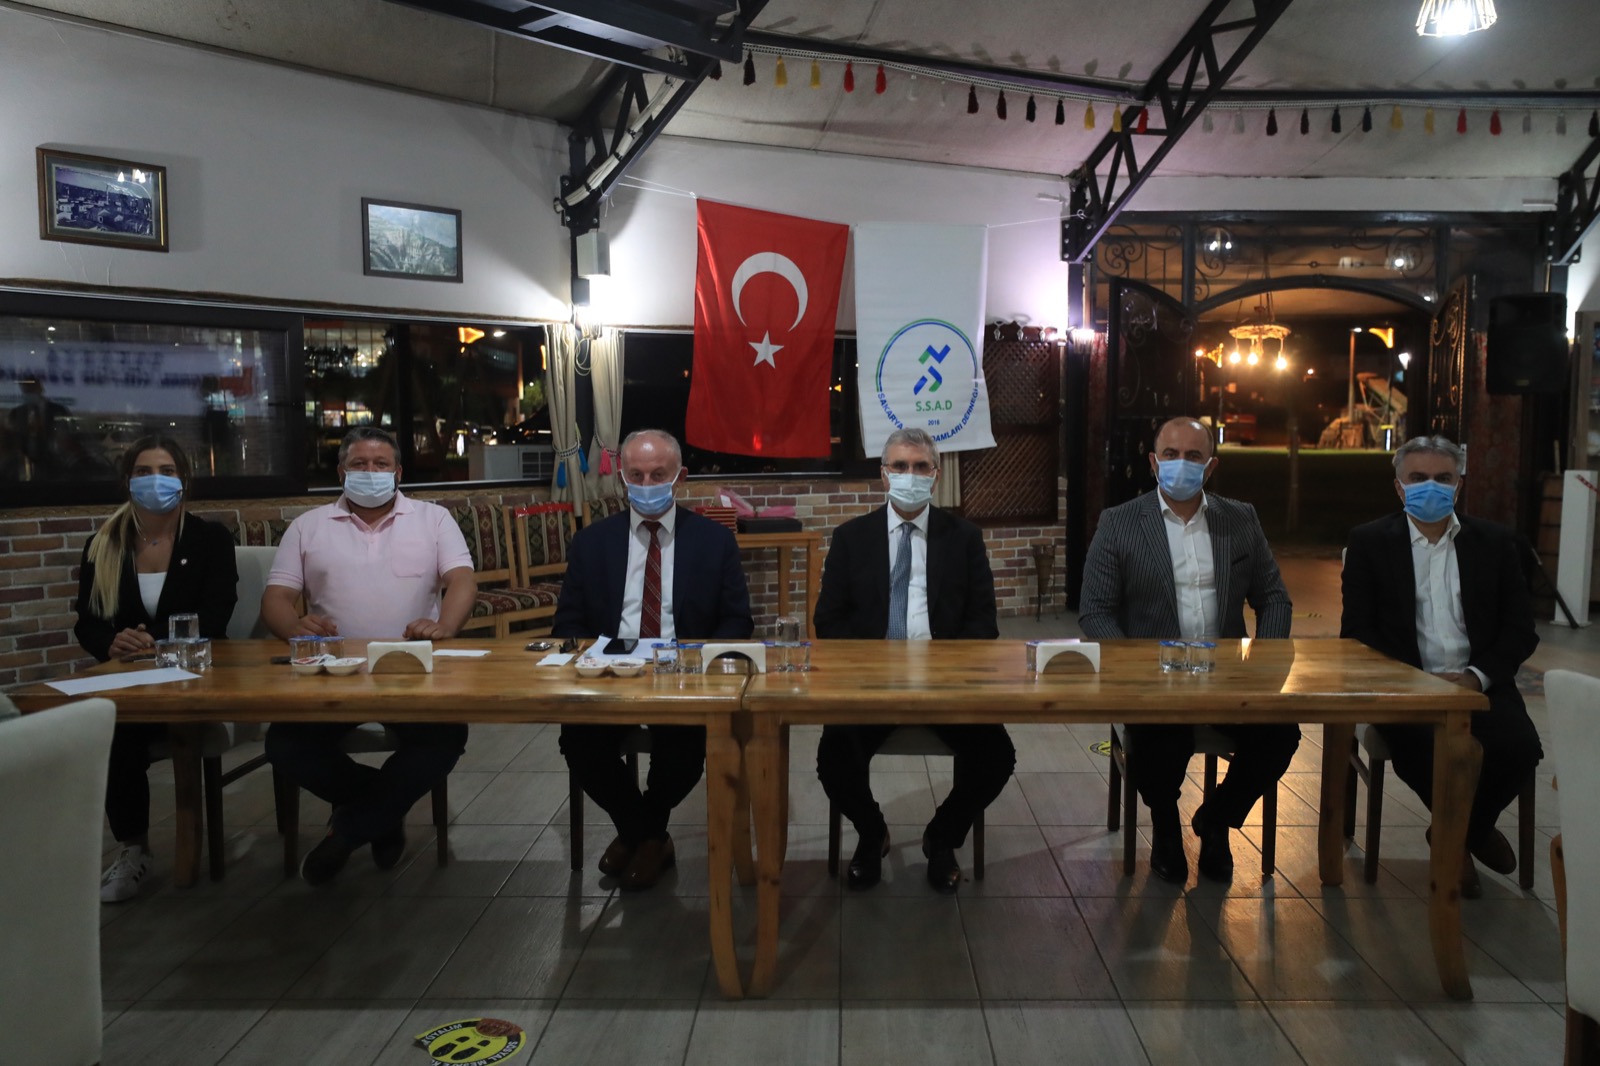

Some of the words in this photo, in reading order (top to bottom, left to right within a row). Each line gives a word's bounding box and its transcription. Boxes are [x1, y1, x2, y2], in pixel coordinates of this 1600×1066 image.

[878, 393, 903, 430] SAKARYA
[932, 424, 963, 442] AMLARI
[916, 400, 952, 412] S.S.A.D
